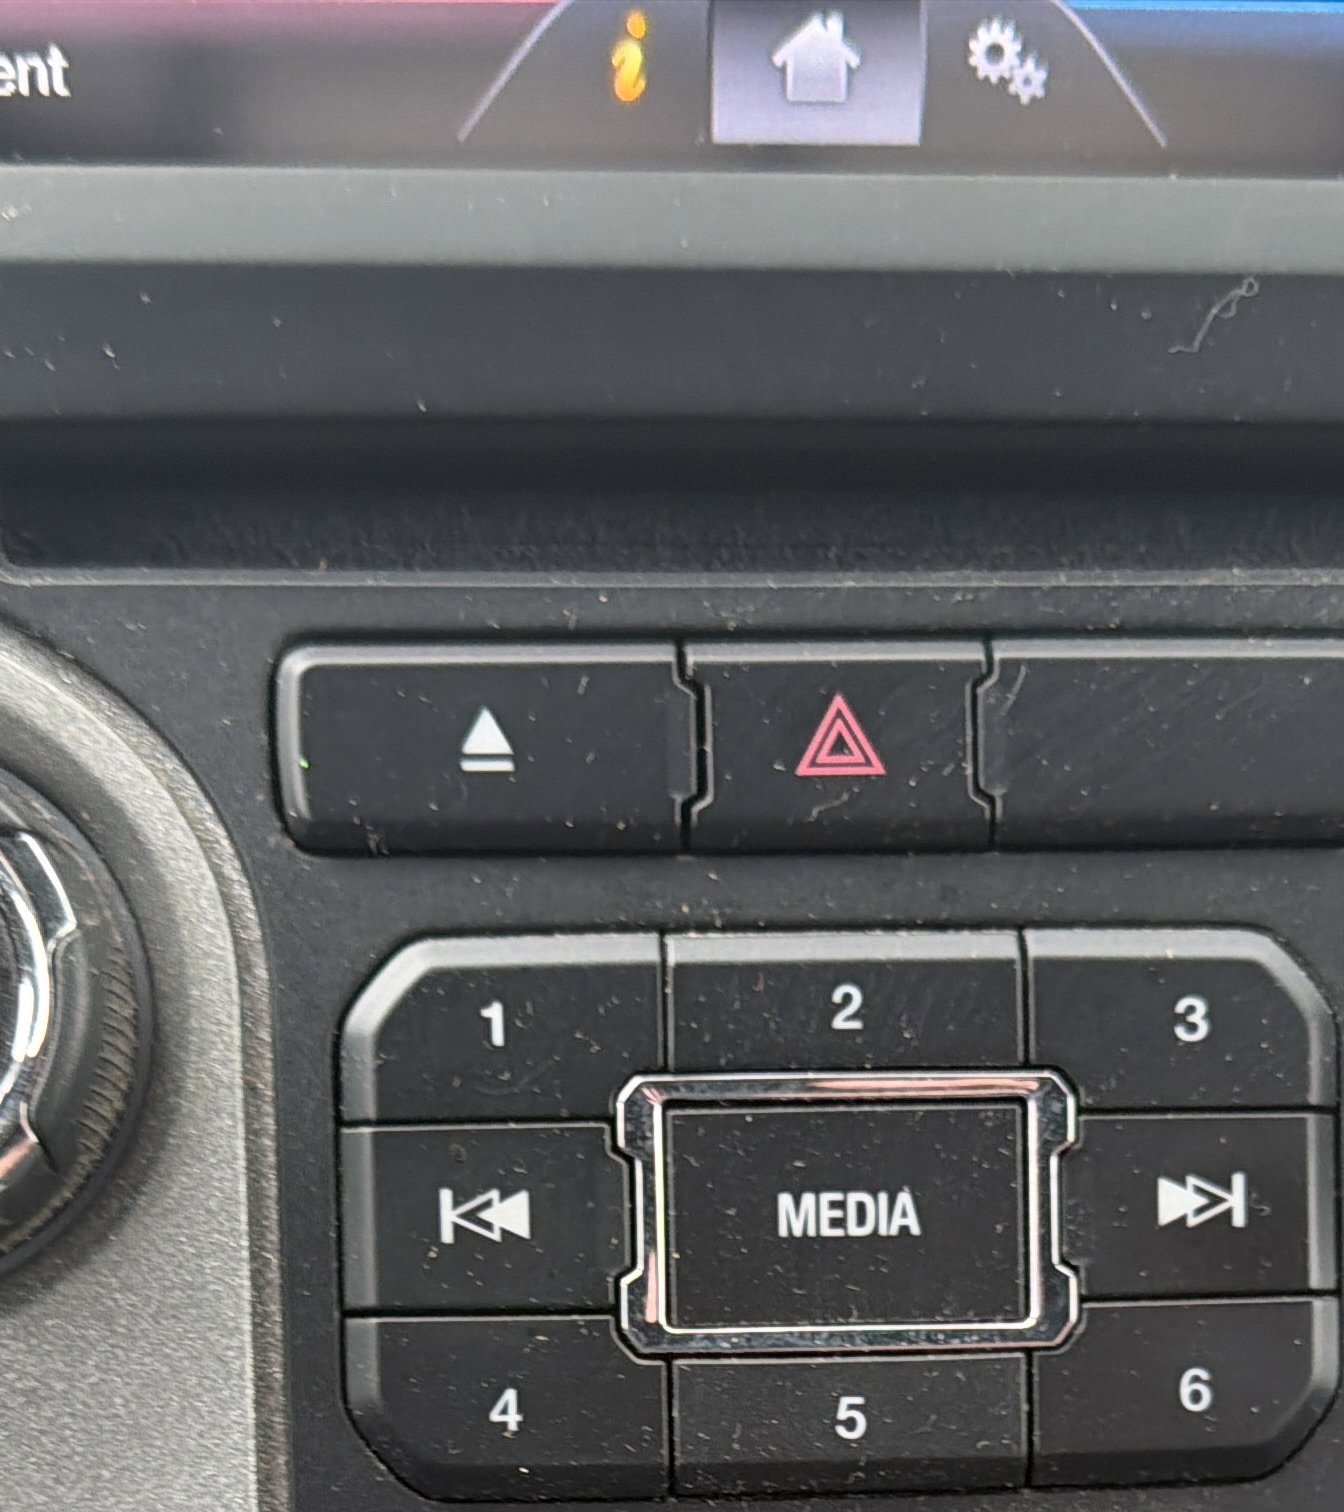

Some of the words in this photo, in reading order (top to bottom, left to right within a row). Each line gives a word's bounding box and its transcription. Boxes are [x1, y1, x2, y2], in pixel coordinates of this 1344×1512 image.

[480, 1001, 505, 1048] 1
[831, 984, 864, 1031] 2
[1173, 995, 1210, 1043] 3
[777, 1191, 921, 1239] MEDIA
[489, 1388, 524, 1433] 4
[1178, 1367, 1213, 1413] 6
[834, 1396, 868, 1441] 5
